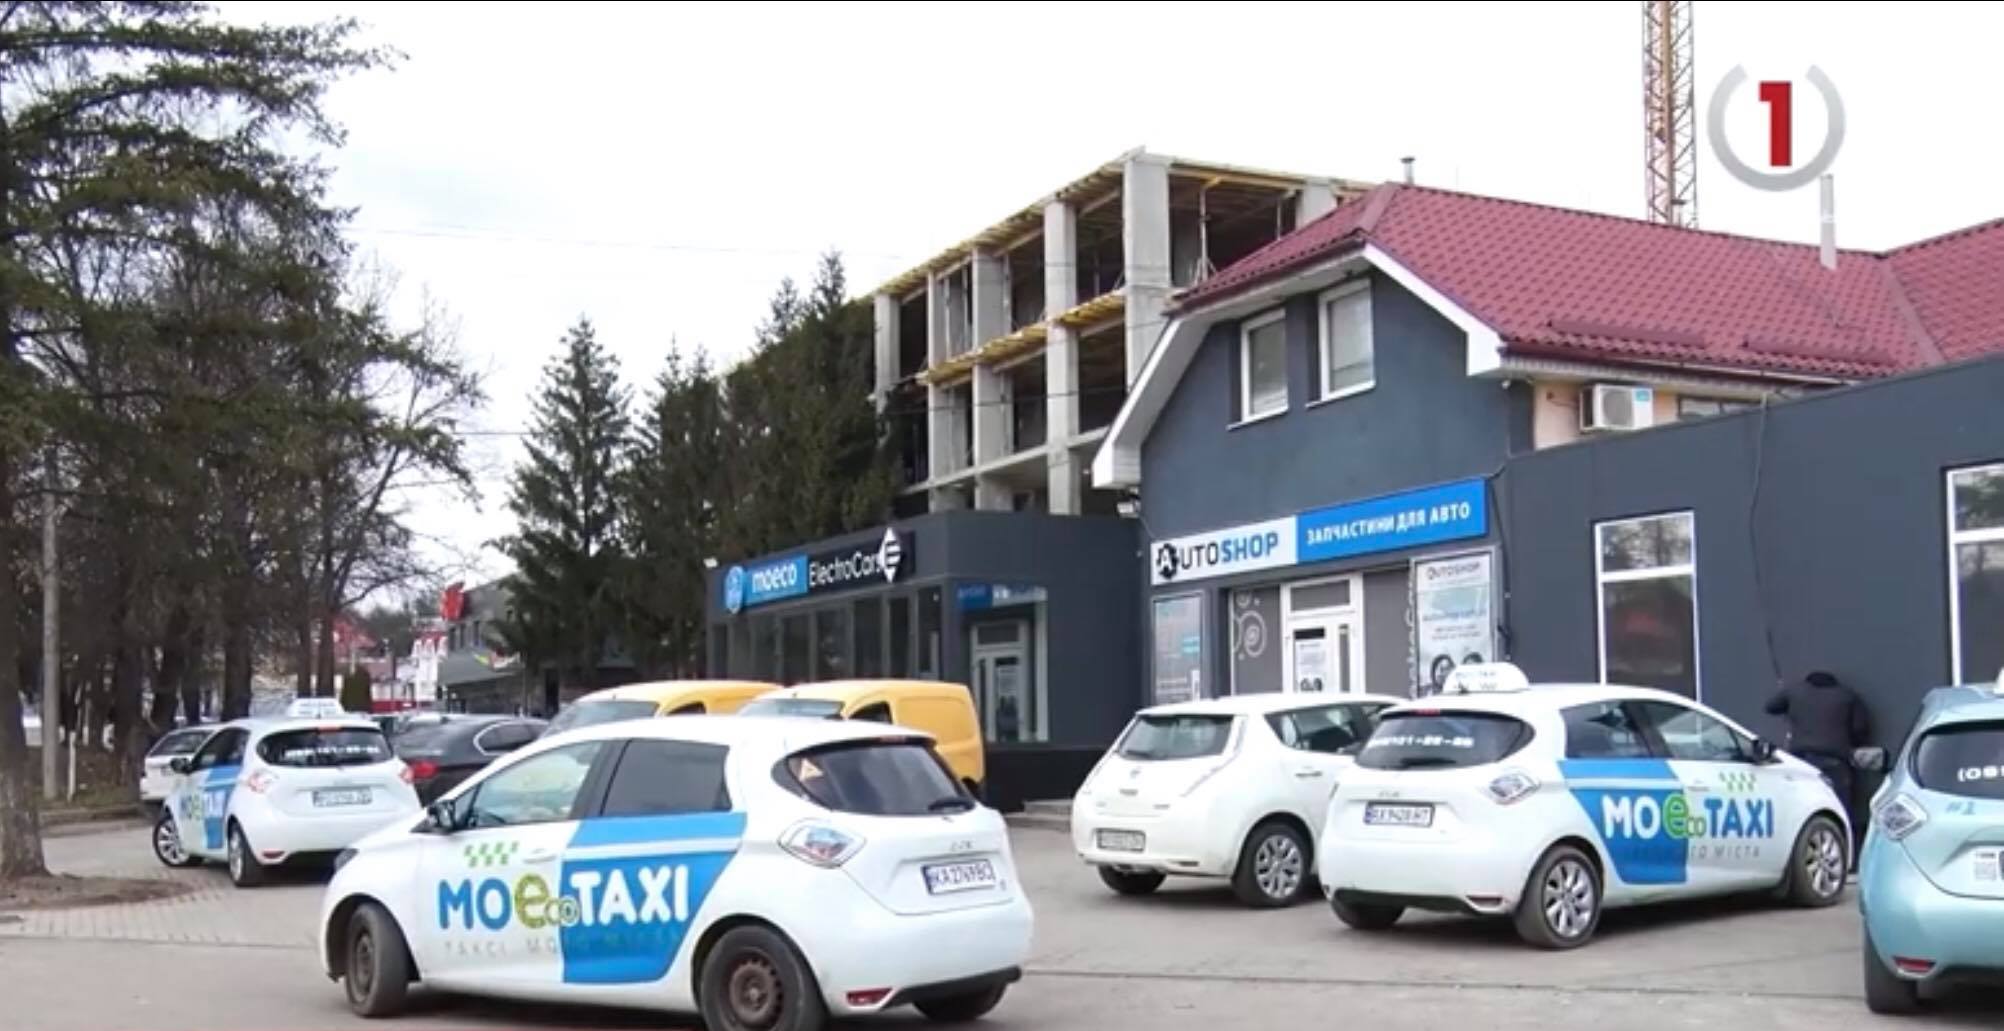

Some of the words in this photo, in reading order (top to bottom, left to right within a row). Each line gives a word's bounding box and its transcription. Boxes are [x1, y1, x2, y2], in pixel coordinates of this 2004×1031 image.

[1307, 514, 1396, 546] ЗАПЧАСТИНИ
[1395, 509, 1426, 532] ДЛЯ
[1430, 501, 1470, 525] АВТО
[751, 562, 799, 594] moeco
